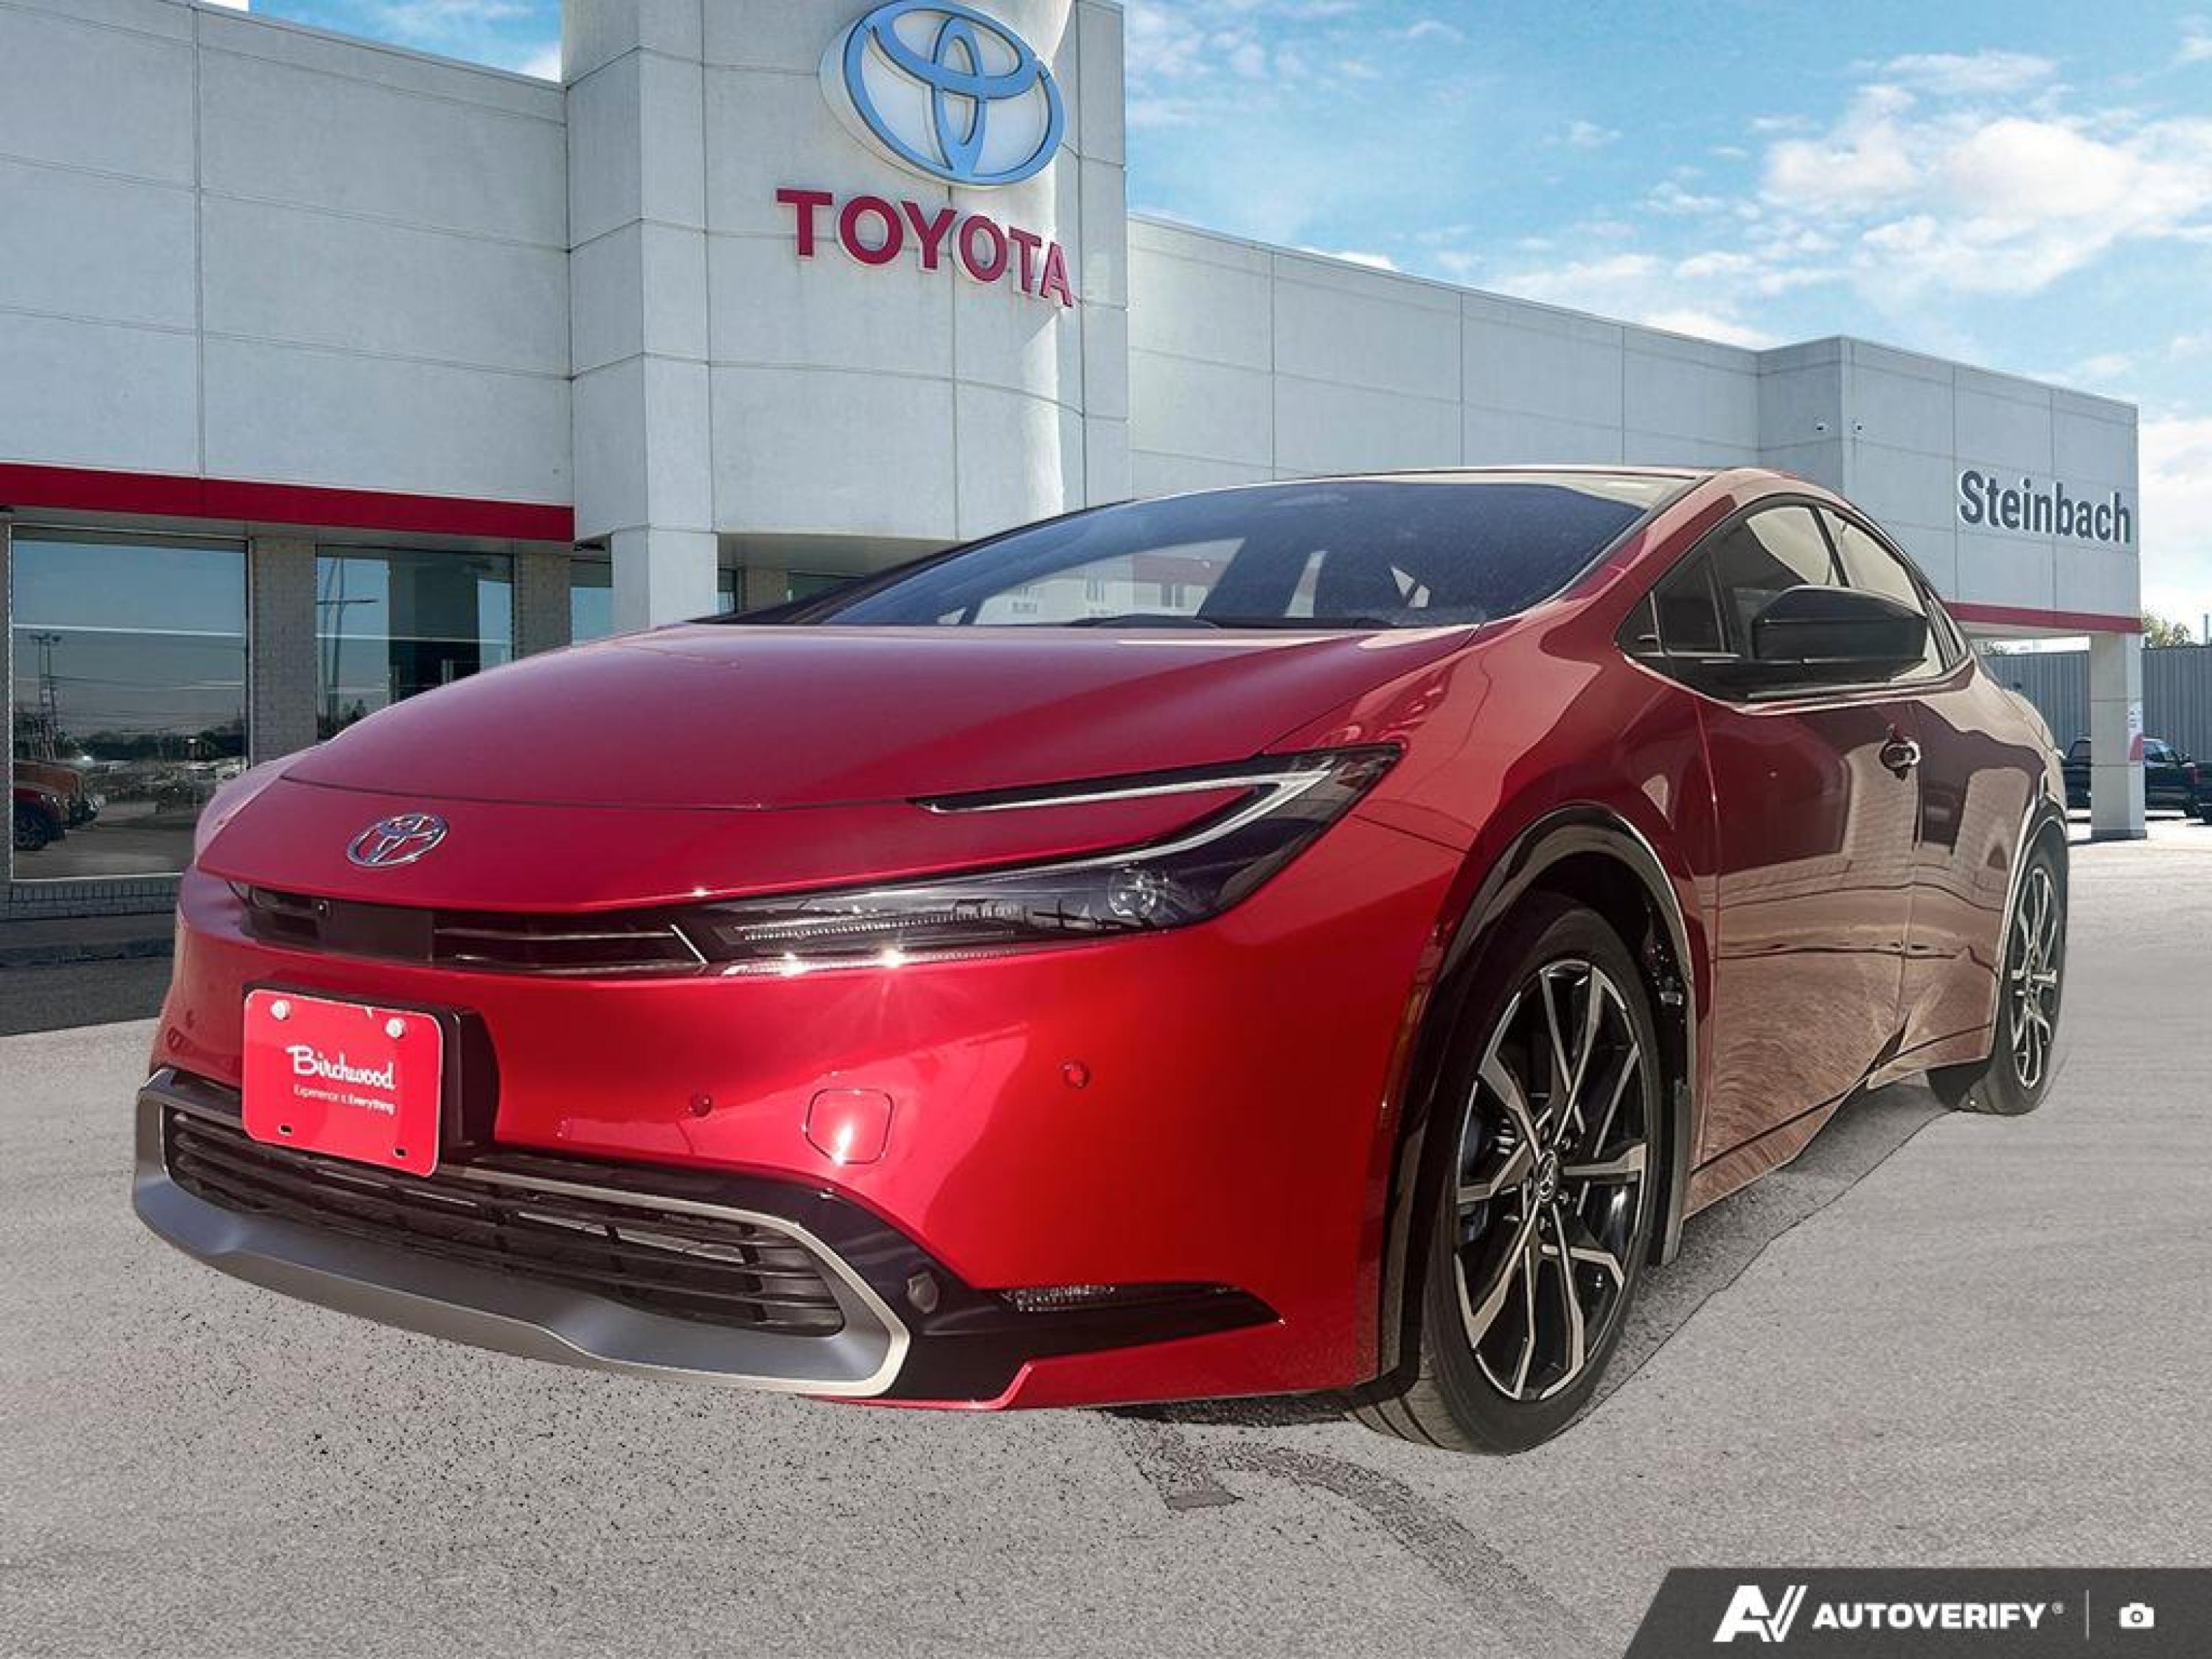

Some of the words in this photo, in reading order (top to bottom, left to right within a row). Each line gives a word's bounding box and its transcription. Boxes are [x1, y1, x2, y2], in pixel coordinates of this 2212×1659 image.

[776, 187, 1073, 307] TOYOTA
[1958, 470, 2130, 543] Steinbach
[285, 1045, 395, 1090] Birchwood
